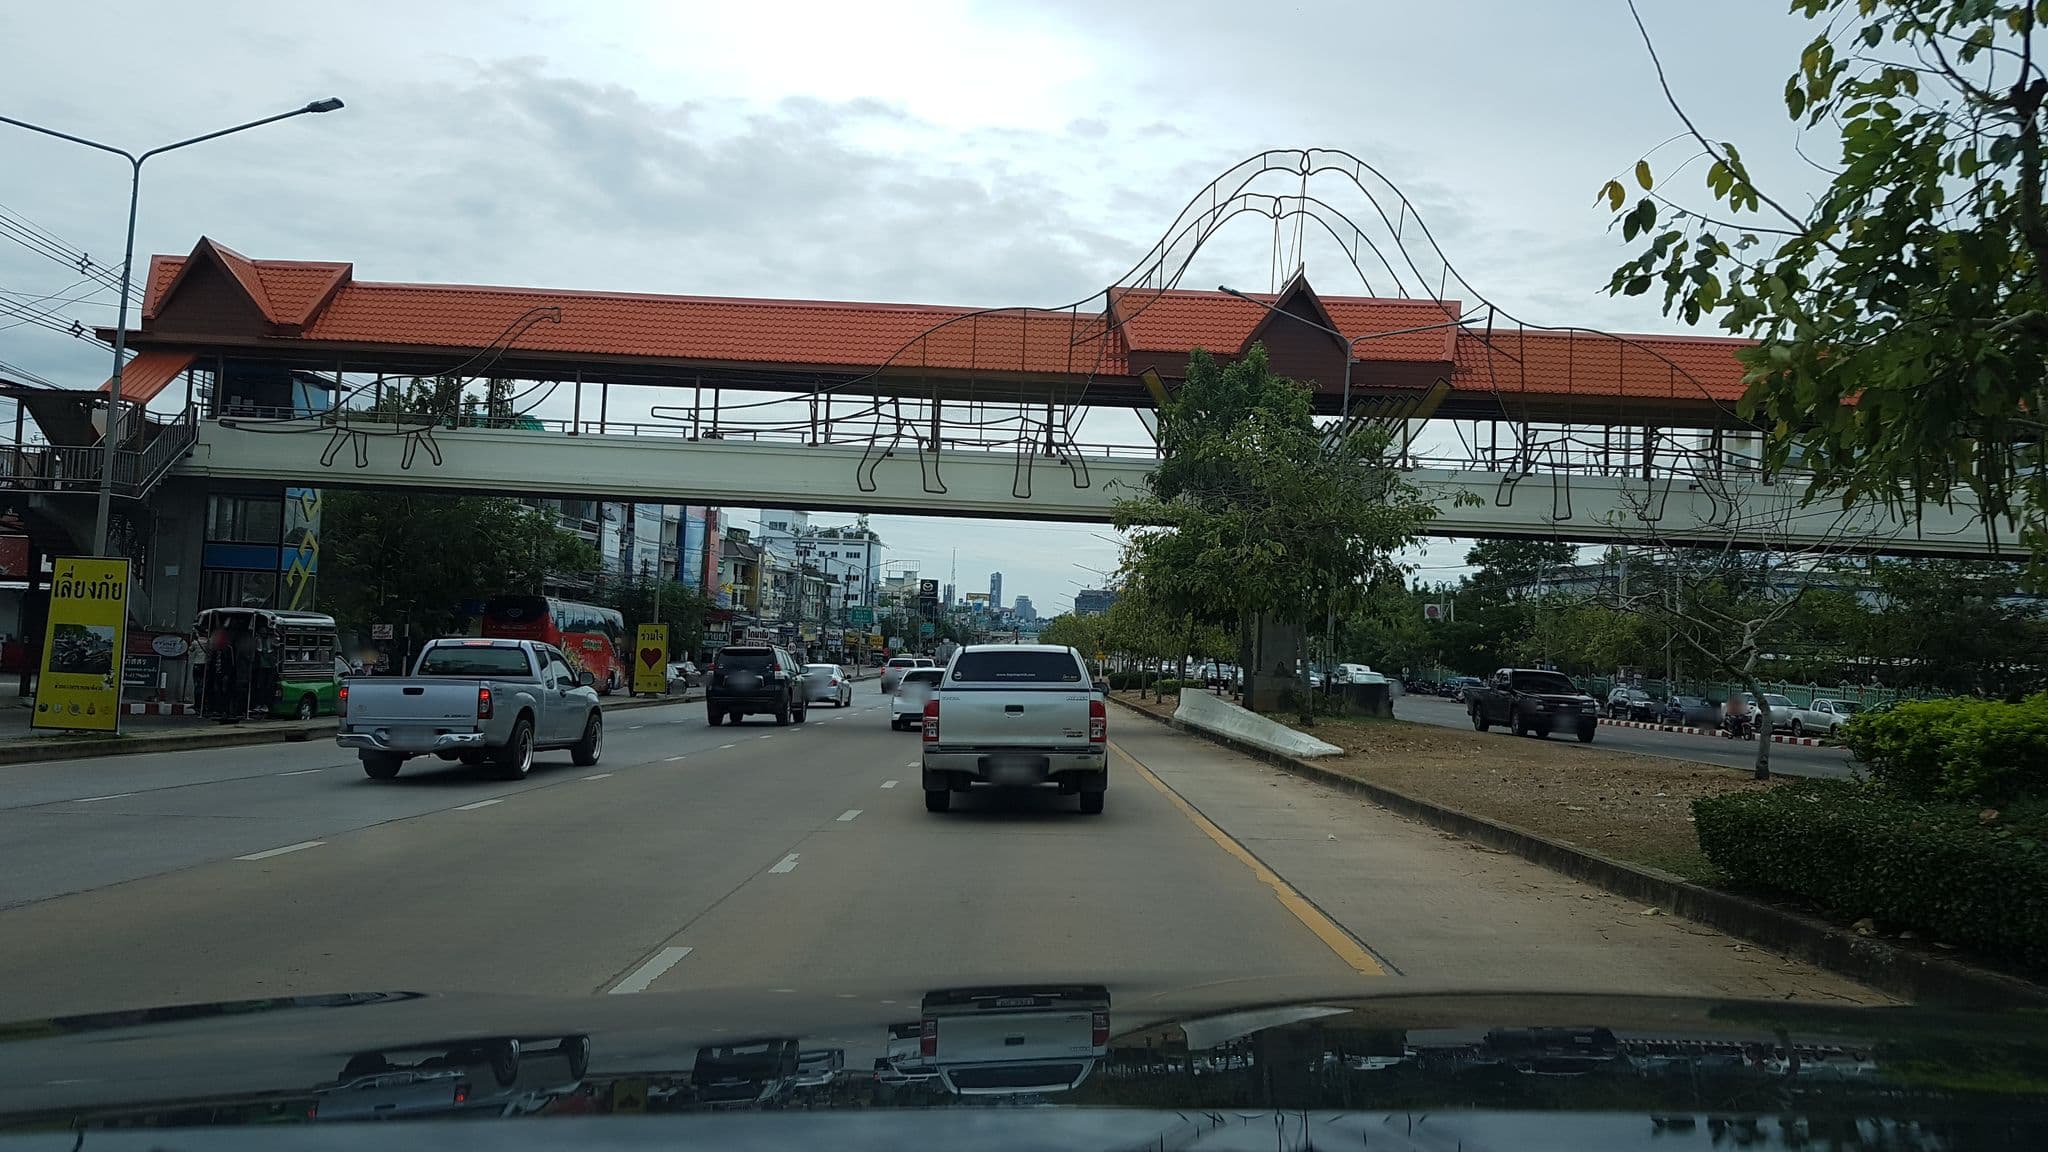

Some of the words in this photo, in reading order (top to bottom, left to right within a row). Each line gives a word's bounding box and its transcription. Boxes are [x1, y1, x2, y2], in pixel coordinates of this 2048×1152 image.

[54, 565, 122, 600] เลี่ยงภัย
[641, 629, 664, 641] ร่วมใจ
